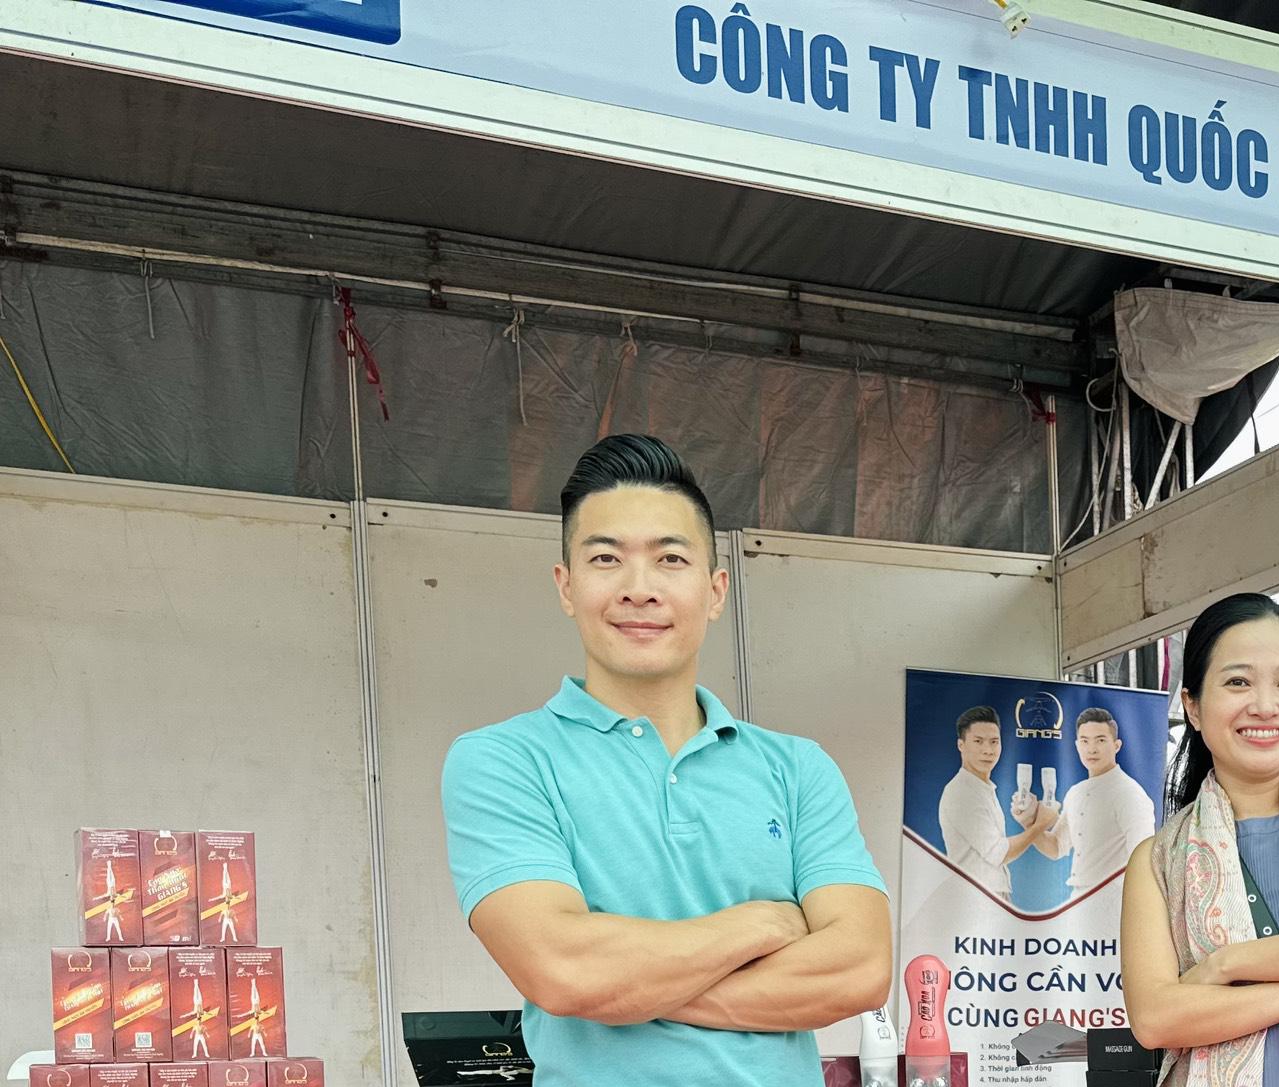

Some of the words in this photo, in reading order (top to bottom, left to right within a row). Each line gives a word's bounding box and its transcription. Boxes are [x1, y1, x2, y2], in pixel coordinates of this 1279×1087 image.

[675, 1, 849, 114] CÔNG
[868, 45, 941, 130] TY
[958, 64, 1108, 166] TNHH
[1128, 100, 1269, 199] QUỐC
[954, 936, 1016, 956] KINH
[1024, 937, 1118, 957] DOANH
[947, 965, 1017, 992] ÔNG
[1026, 964, 1086, 992] CẦN
[947, 1003, 1018, 1027] CÙNG
[1024, 1008, 1125, 1027] GIANG'S
